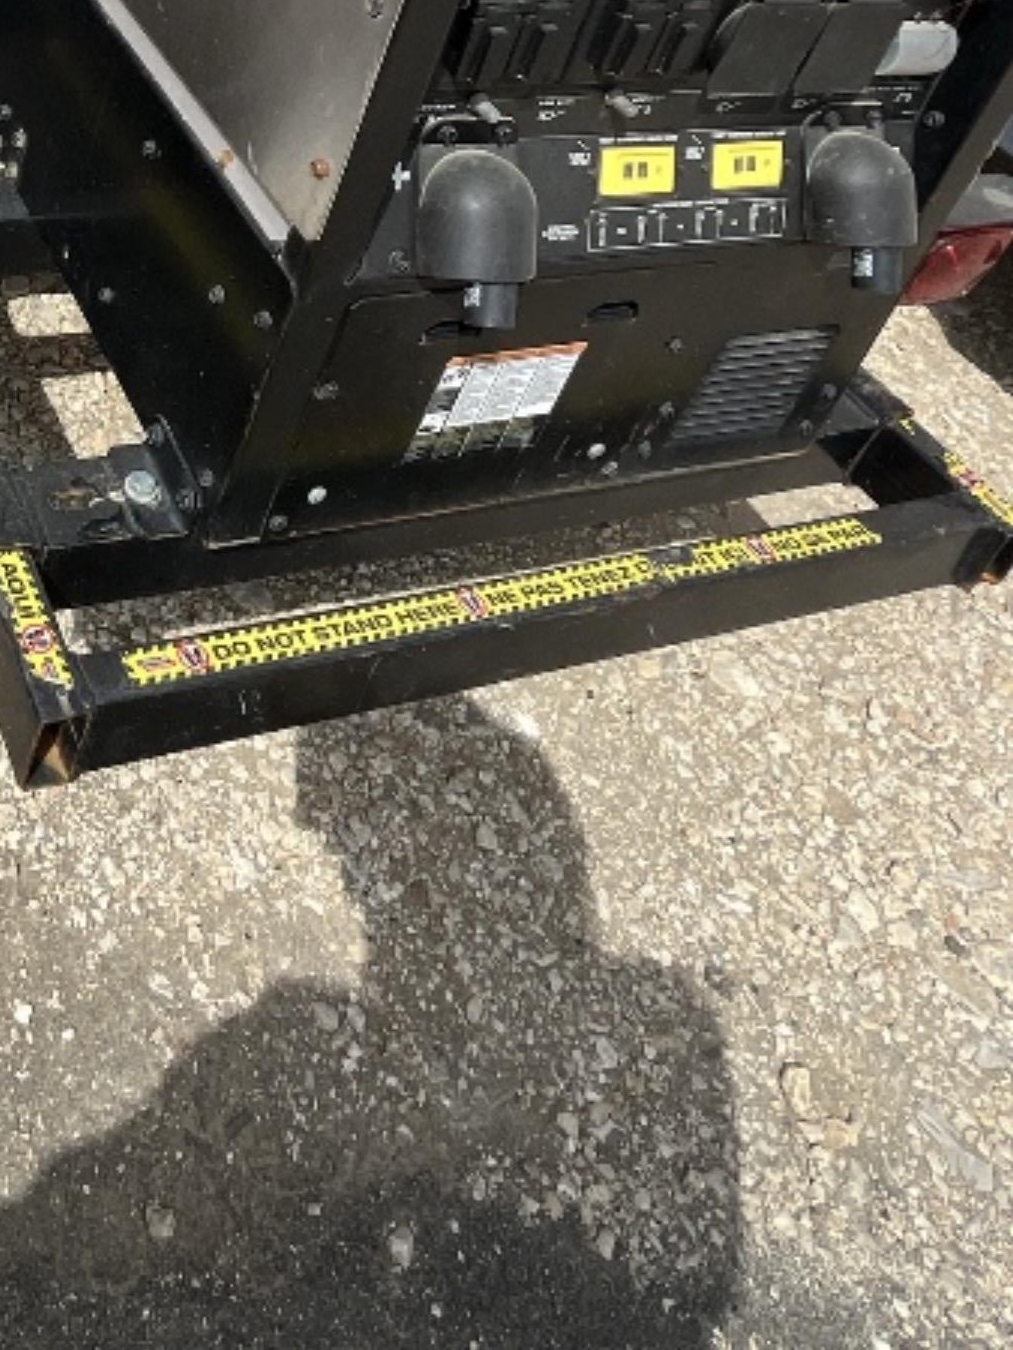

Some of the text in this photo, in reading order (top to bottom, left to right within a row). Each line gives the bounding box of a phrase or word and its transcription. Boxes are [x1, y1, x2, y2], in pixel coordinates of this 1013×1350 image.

[485, 586, 520, 607] NE
[520, 578, 566, 601] PAS
[567, 564, 640, 594] TENEZ
[212, 600, 462, 661] DO NOT STAND HERE
